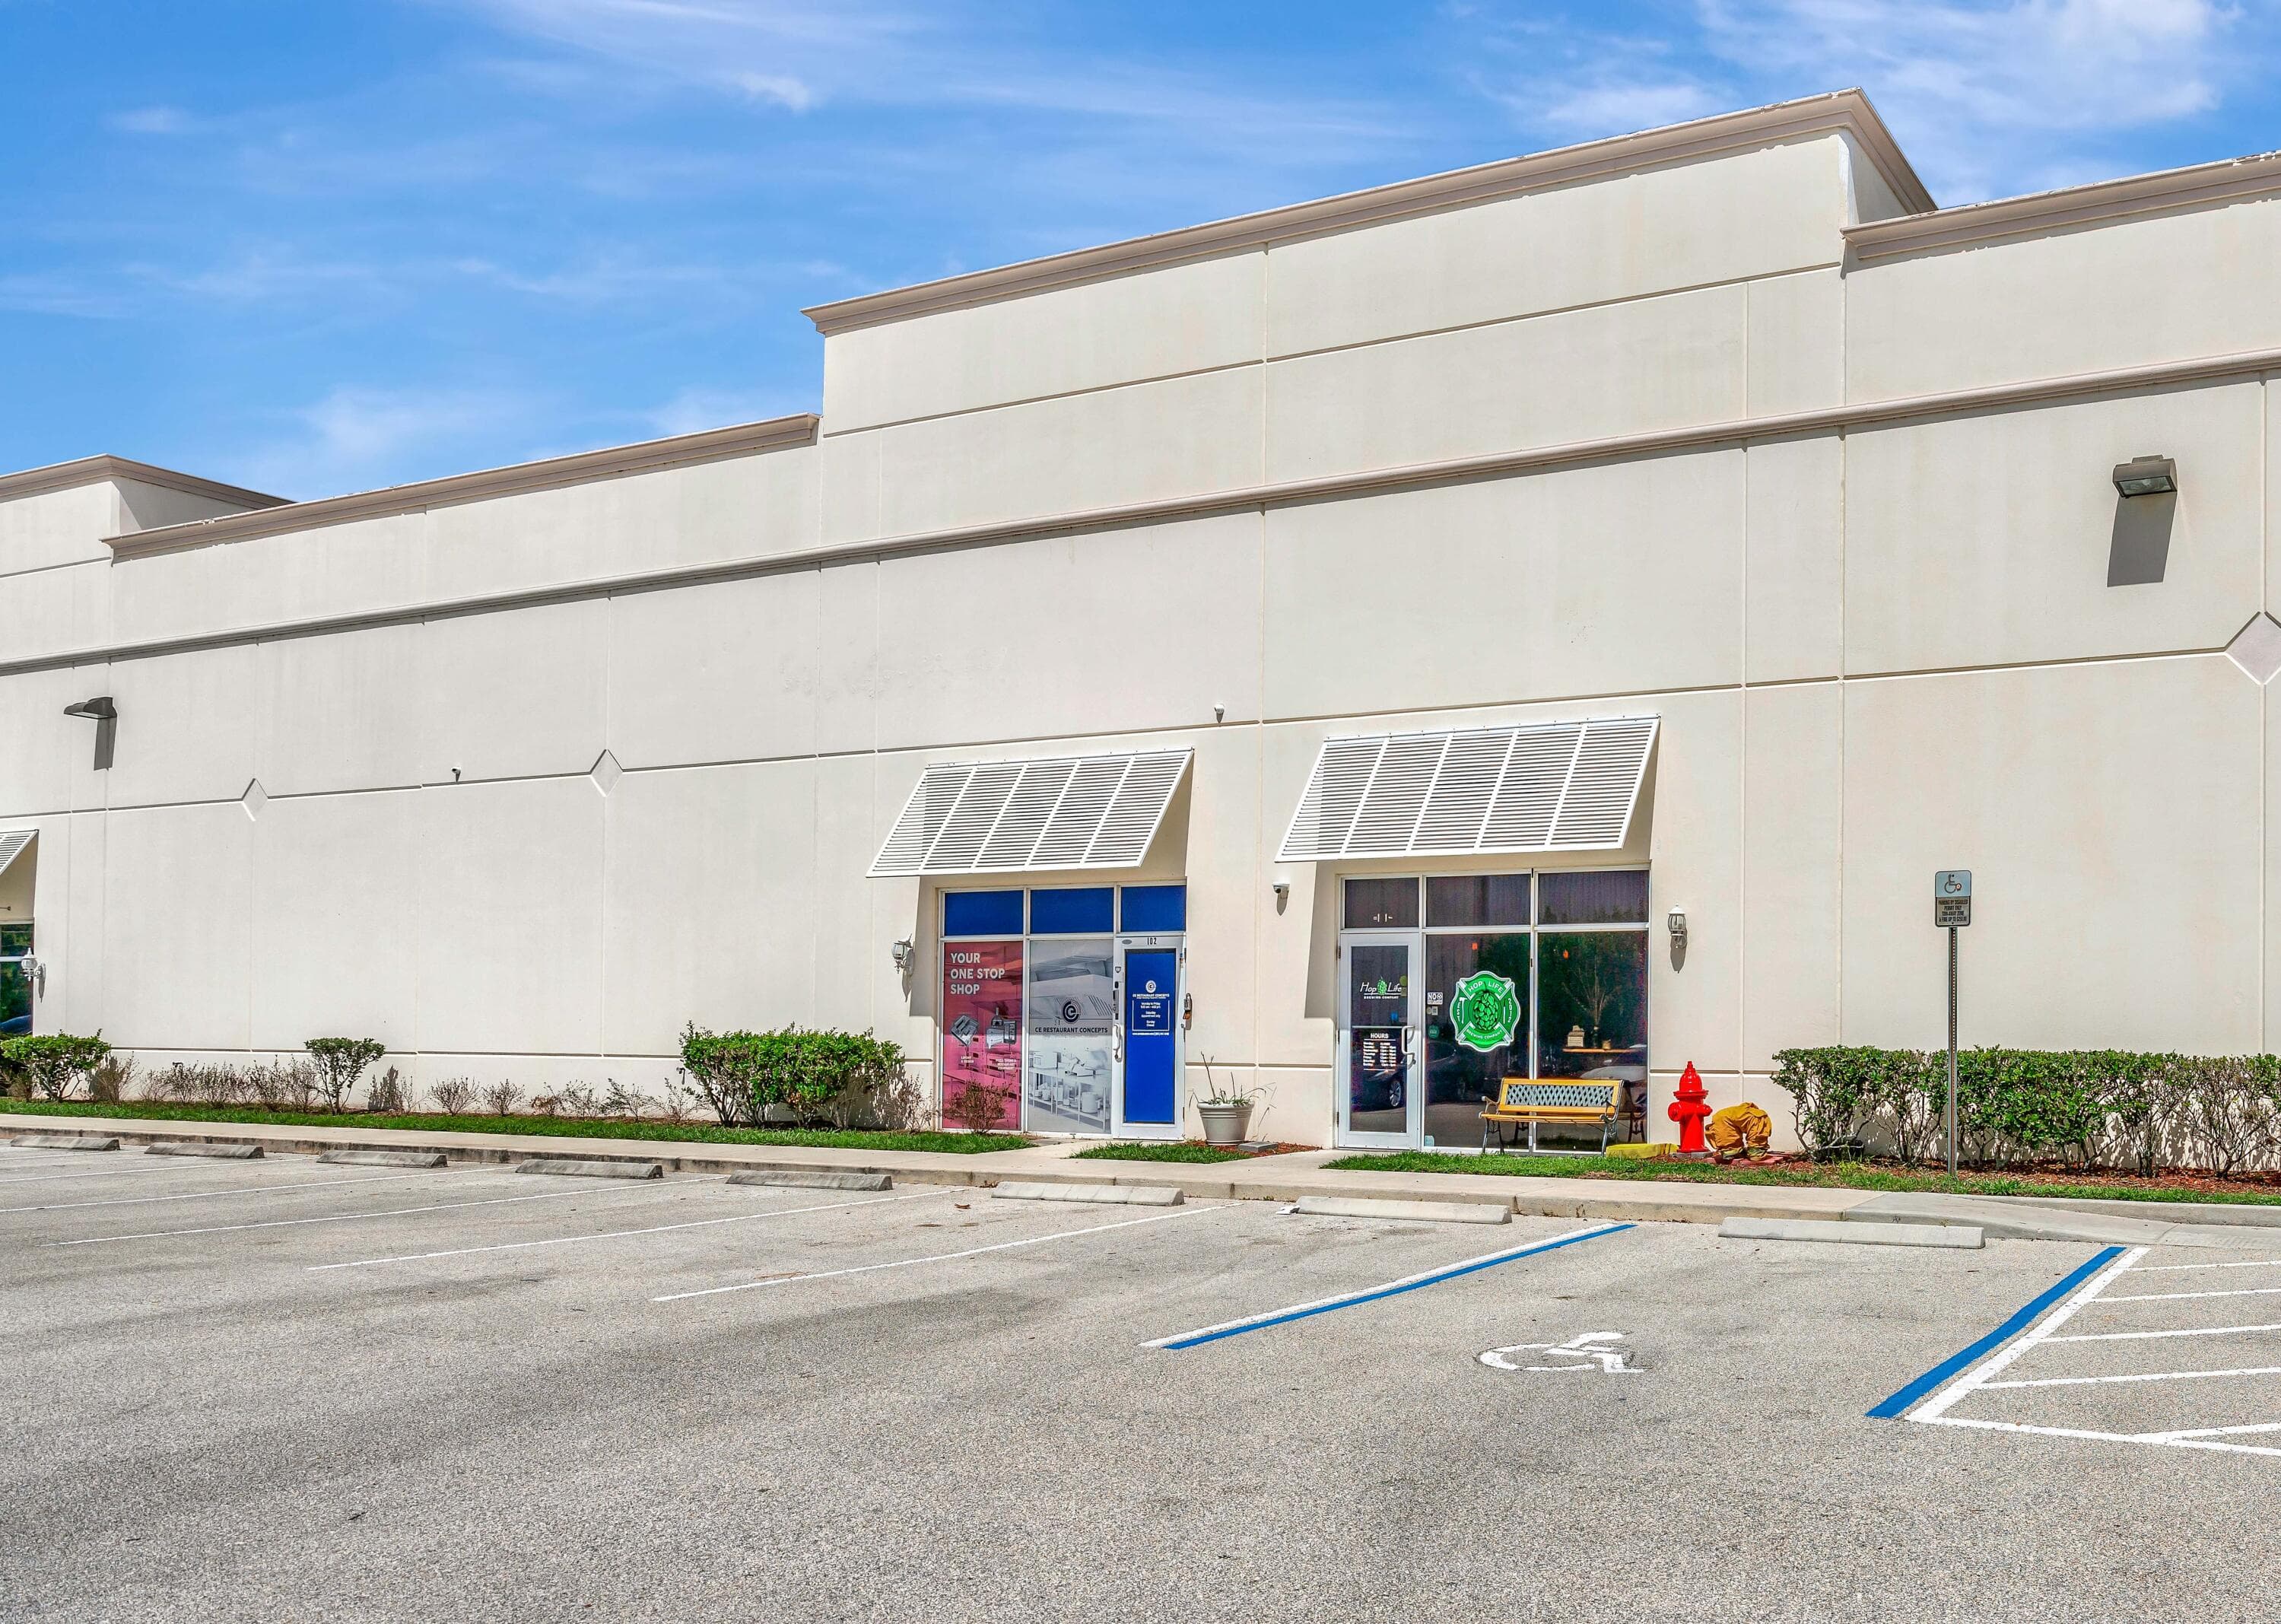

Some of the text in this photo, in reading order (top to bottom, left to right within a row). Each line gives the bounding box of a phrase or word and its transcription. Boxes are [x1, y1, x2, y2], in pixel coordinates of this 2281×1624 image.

[1147, 937, 1157, 945] 102
[950, 952, 980, 964] YOUR
[950, 968, 1005, 980] ONE STOP
[950, 984, 980, 995] SHOP
[1359, 982, 1402, 995] Hop Life
[1468, 980, 1504, 993] HOP LIFE
[1484, 1029, 1503, 1040] COMPANY
